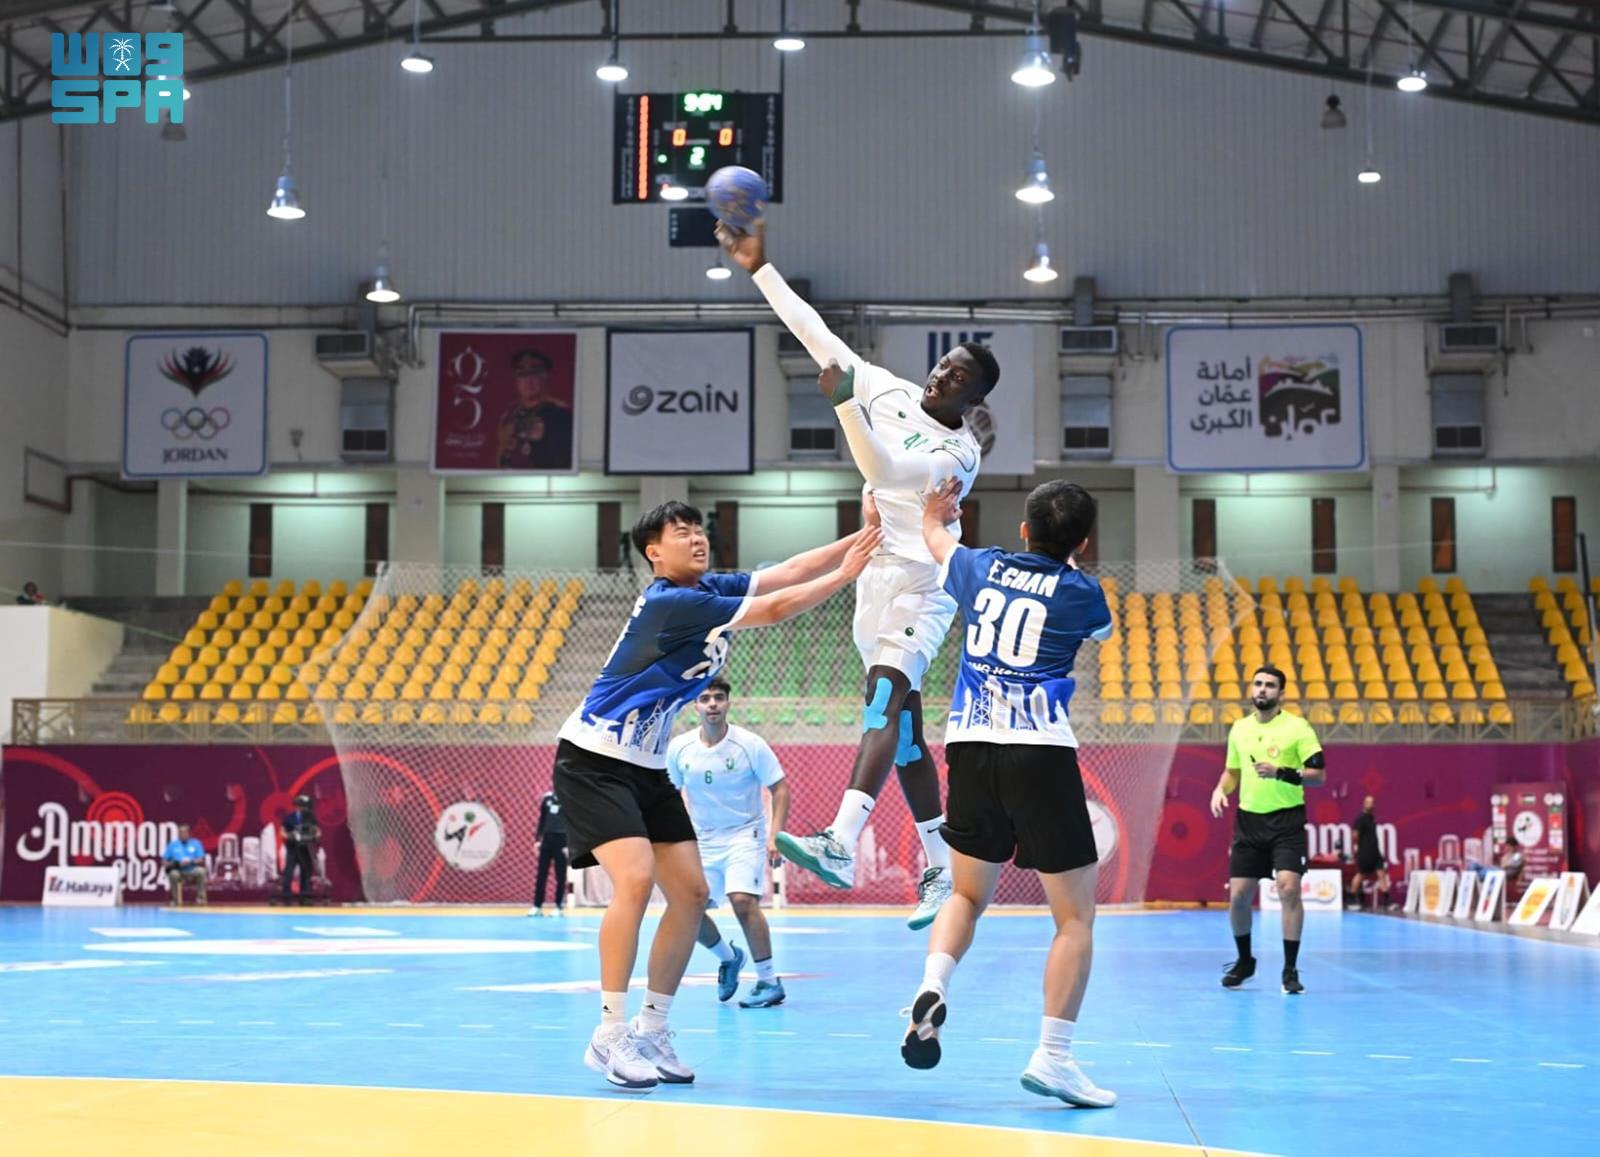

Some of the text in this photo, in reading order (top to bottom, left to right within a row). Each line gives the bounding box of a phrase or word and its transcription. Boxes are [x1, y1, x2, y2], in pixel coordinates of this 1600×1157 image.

[673, 129, 686, 146] 0
[719, 129, 733, 146] 0
[690, 147, 705, 165] 2
[1197, 355, 1251, 381] أمانة
[656, 383, 738, 413] zain
[1190, 408, 1252, 435] الكبرى
[162, 449, 228, 464] JORDAN
[966, 587, 1047, 668] 30
[704, 770, 713, 785] 6
